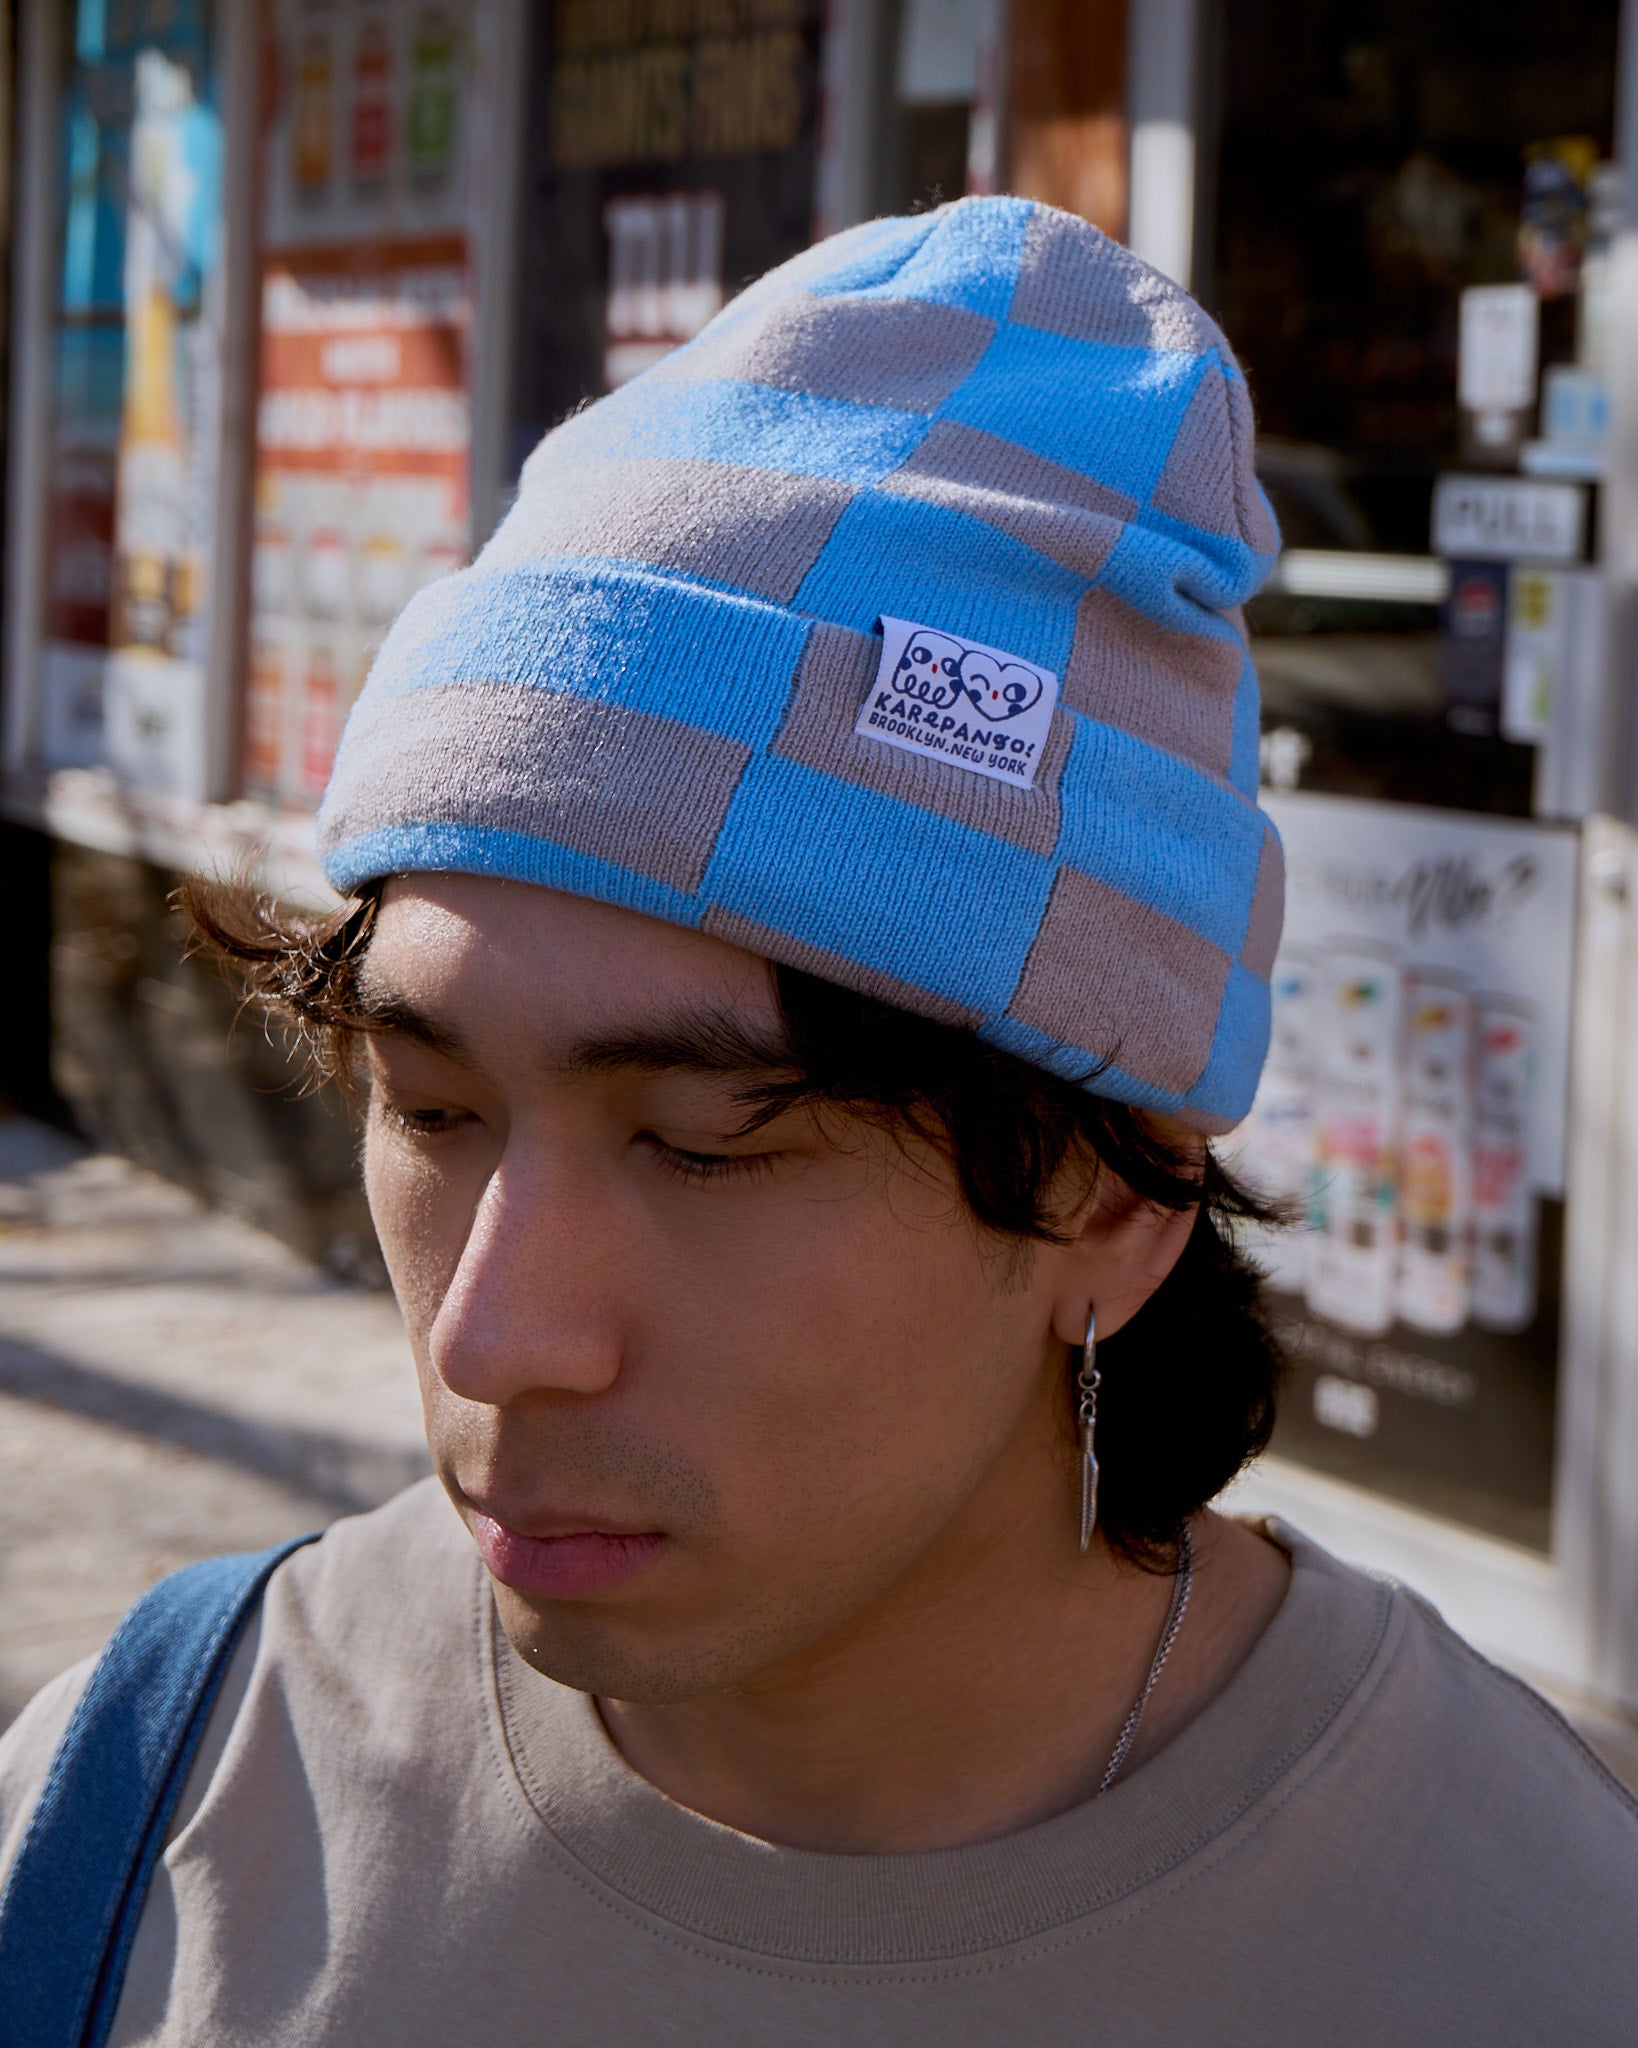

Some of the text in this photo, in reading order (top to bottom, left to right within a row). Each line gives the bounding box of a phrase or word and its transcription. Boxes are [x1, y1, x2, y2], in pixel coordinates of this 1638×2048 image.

[1454, 495, 1558, 543] PULL
[950, 743, 985, 764] NEW
[988, 752, 1028, 776] YORK
